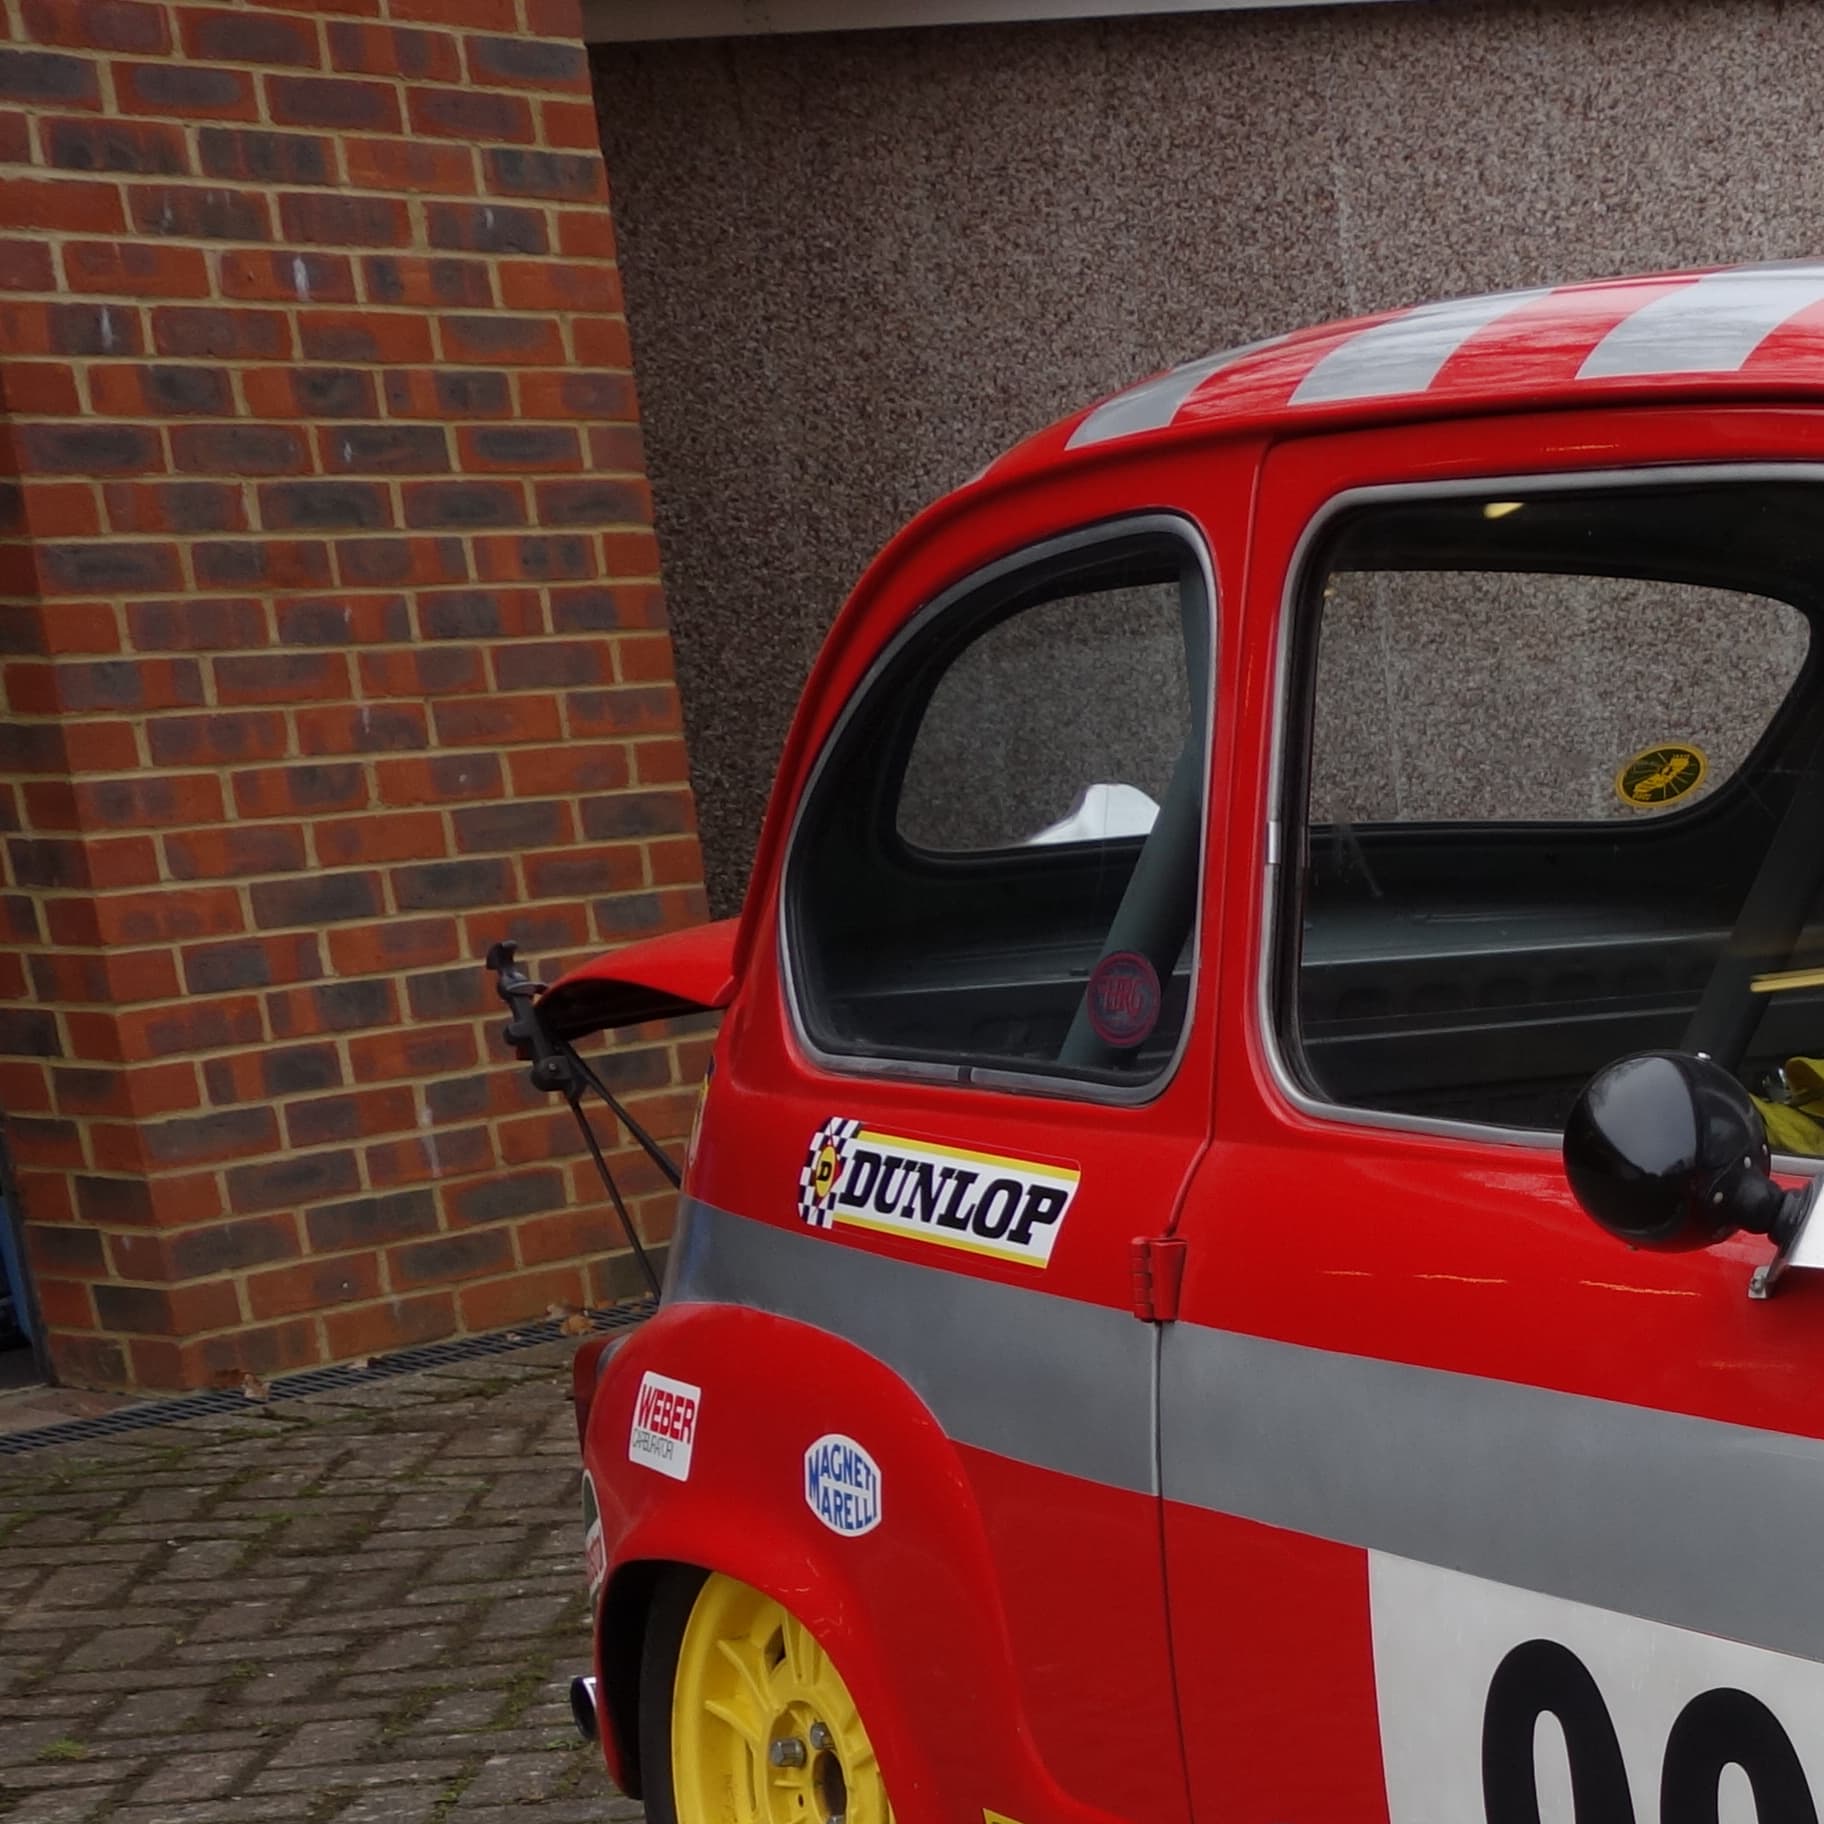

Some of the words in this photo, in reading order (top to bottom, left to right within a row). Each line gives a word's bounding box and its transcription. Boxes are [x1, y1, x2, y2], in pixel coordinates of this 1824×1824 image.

[816, 1161, 833, 1183] D
[838, 1149, 1069, 1245] DUNLOP
[637, 1383, 695, 1445] WEBER
[808, 1443, 877, 1497] MAGNETI
[808, 1482, 877, 1530] MARELLI
